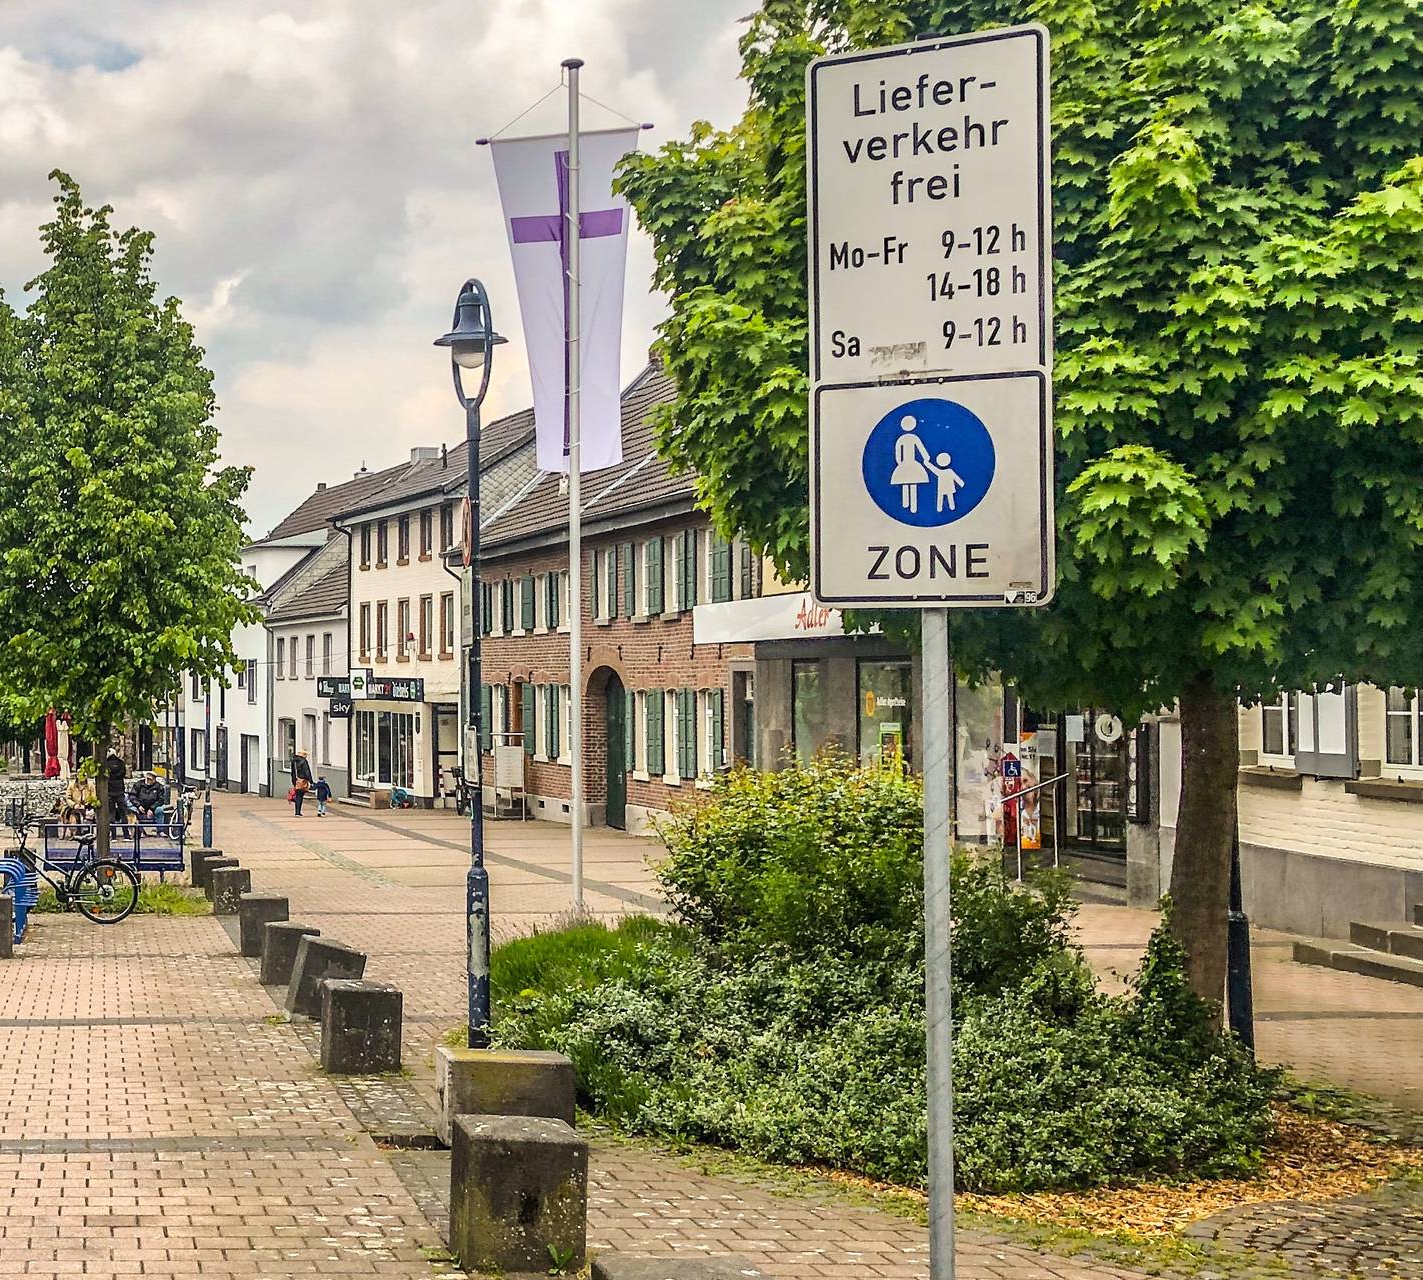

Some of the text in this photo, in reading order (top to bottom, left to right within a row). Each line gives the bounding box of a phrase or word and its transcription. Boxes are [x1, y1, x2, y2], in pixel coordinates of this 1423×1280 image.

[853, 73, 997, 117] Liefer-
[842, 115, 1009, 164] verkehr
[890, 164, 960, 205] frei
[829, 224, 1026, 271] Mo-Fr 9-12 h
[927, 266, 1026, 301] 14-18 h
[831, 315, 1026, 358] Sa 9-12 h
[867, 544, 990, 580] ZONE
[795, 598, 830, 631] Adler
[1025, 592, 1037, 603] 96
[333, 702, 350, 713] sky
